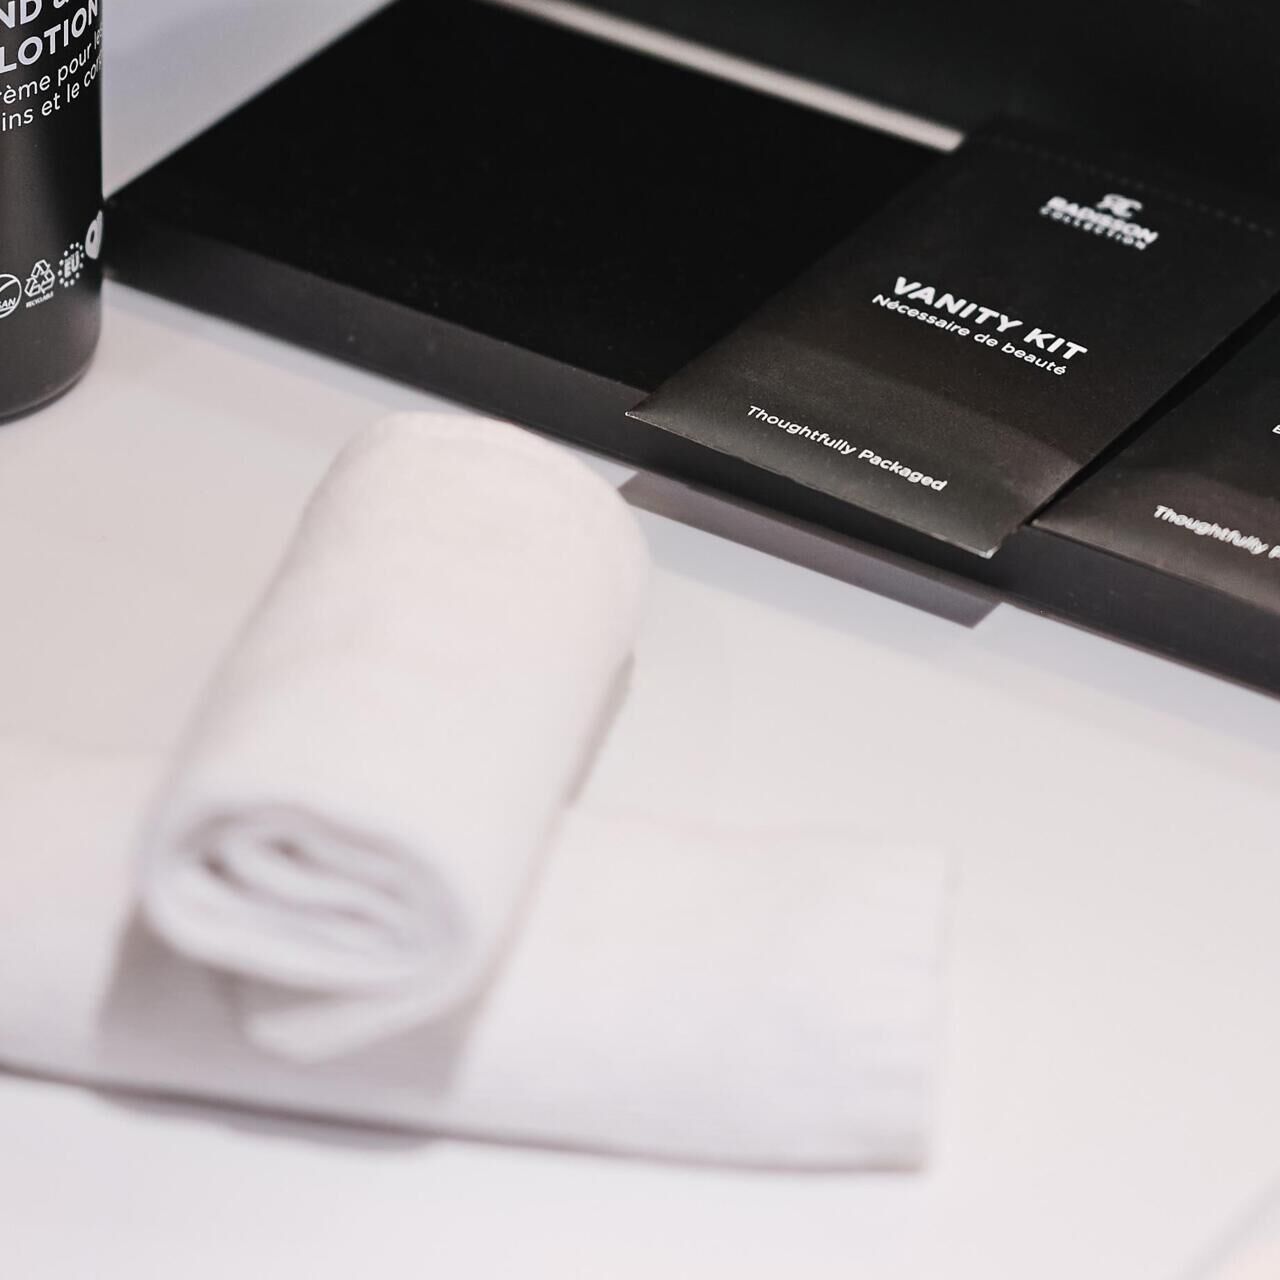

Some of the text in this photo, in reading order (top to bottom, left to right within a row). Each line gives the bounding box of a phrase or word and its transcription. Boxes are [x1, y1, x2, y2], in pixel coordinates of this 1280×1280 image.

[58, 42, 92, 86] pour
[41, 92, 61, 117] et
[67, 82, 80, 103] le
[872, 294, 1067, 375] Nécessaire de beauté
[893, 276, 1089, 360] VANITY KIT
[747, 405, 948, 491] Thoughtfully Packaged
[1153, 504, 1270, 555] Thoughtfully
